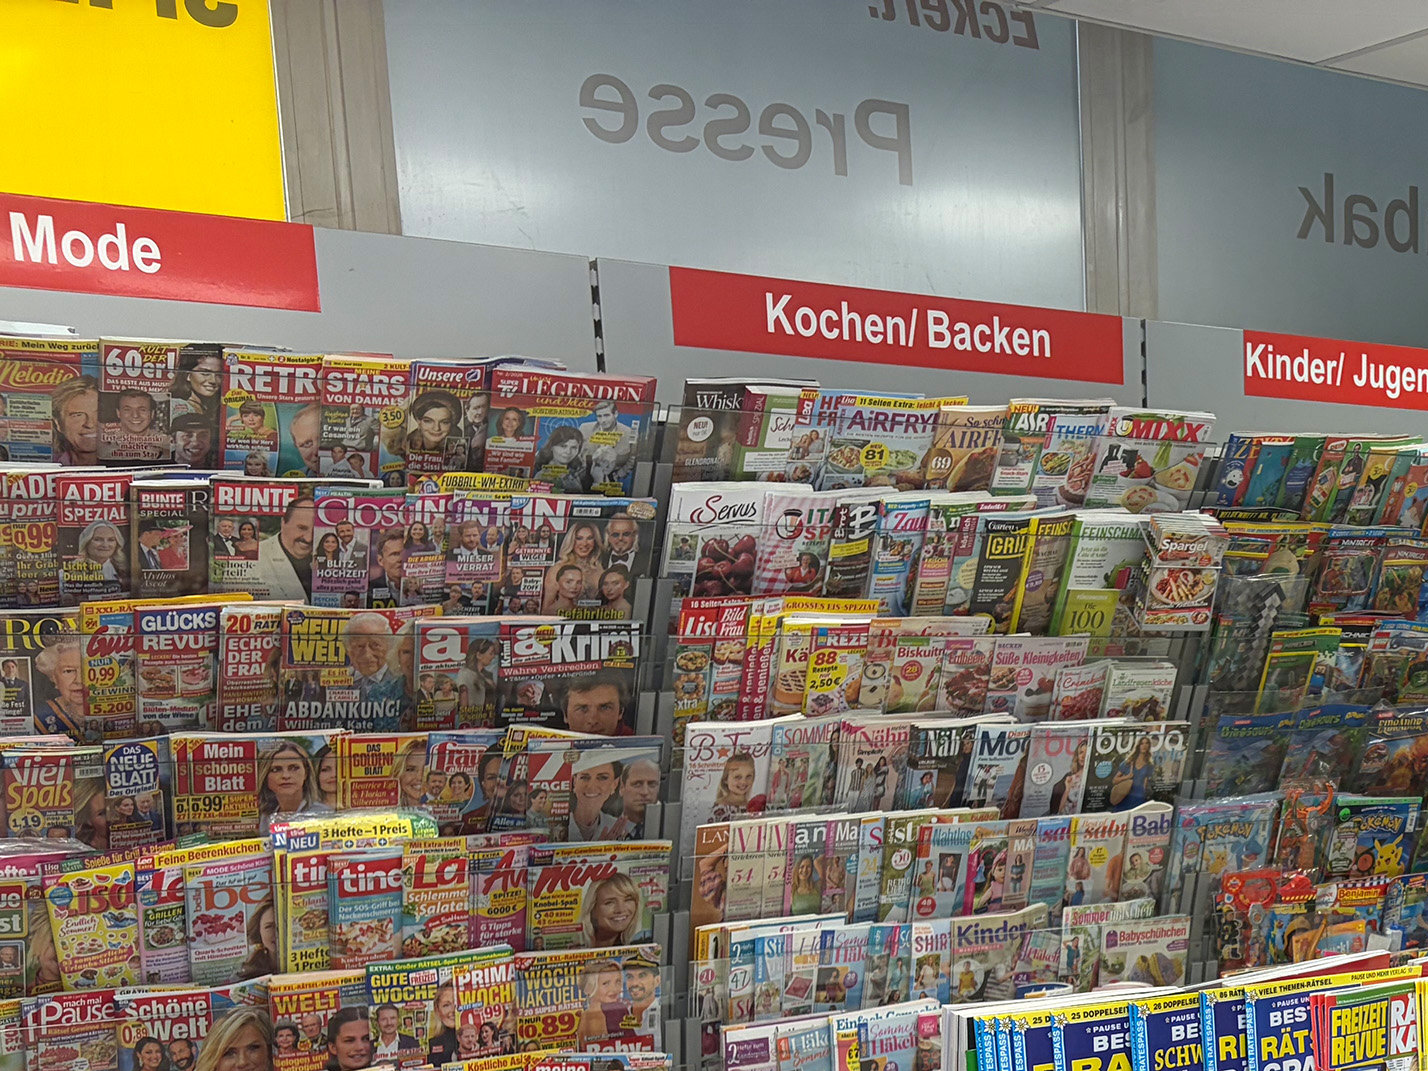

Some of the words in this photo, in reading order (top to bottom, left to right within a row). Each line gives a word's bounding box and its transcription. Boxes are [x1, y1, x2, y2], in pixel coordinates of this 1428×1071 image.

[10, 212, 162, 274] Mode
[765, 292, 917, 350] Kochen/
[929, 310, 1051, 359] Backen
[106, 348, 175, 380] 60er!
[354, 368, 381, 376] MEINE
[1246, 344, 1344, 387] Kinder/
[418, 367, 463, 383] Unsere
[326, 372, 407, 396] STARS
[521, 378, 643, 402] LEGENDEN
[327, 394, 352, 403] VON
[355, 395, 404, 405] DAMALS
[65, 483, 127, 503] ADEL
[141, 492, 184, 509] BUNTE
[218, 485, 295, 513] BUNTE
[64, 507, 127, 522] SPEZIAL
[140, 509, 184, 517] SPECIAL
[705, 496, 757, 524] Servus
[1162, 539, 1208, 554] Spargel
[456, 562, 494, 571] VERRAT
[458, 554, 494, 564] MIESER
[557, 608, 624, 620] Gefährliche
[722, 607, 746, 621] Bild
[786, 602, 825, 612] GROSSES
[827, 602, 876, 611] EIS-SPEZIAL
[141, 611, 216, 631] GLÜCKS
[143, 634, 216, 650] REVUE
[815, 651, 837, 665] 88
[996, 650, 1022, 665] Süße
[1024, 650, 1085, 665] Kleinigkeiten
[503, 665, 537, 675] Wahre
[540, 662, 598, 673] Verbrechen
[812, 665, 838, 673] Rezepte
[286, 700, 400, 720] ABDANKUNG!
[1096, 725, 1184, 755] burda
[123, 747, 141, 755] DAS
[204, 744, 243, 758] Mein
[10, 757, 67, 786] Viel
[111, 756, 154, 771] NEUE
[195, 761, 253, 775] schönes
[109, 771, 157, 788] BLATT
[205, 776, 245, 792] Blatt
[531, 781, 569, 791] TAGE
[7, 782, 72, 809] Spaß
[158, 853, 186, 865] Feine
[188, 842, 260, 863] Beerenkuchen
[534, 855, 617, 897] Mini
[1338, 888, 1380, 899] Benjamin
[1118, 926, 1187, 943] Babyschühchen
[63, 999, 89, 1008] mach
[91, 996, 102, 1004] mal
[125, 1000, 207, 1020] Schöne
[41, 1001, 115, 1024] Pause
[1331, 1001, 1388, 1039] FREIZEIT
[151, 1019, 209, 1040] Welt
[1332, 1029, 1388, 1066] REVUE
